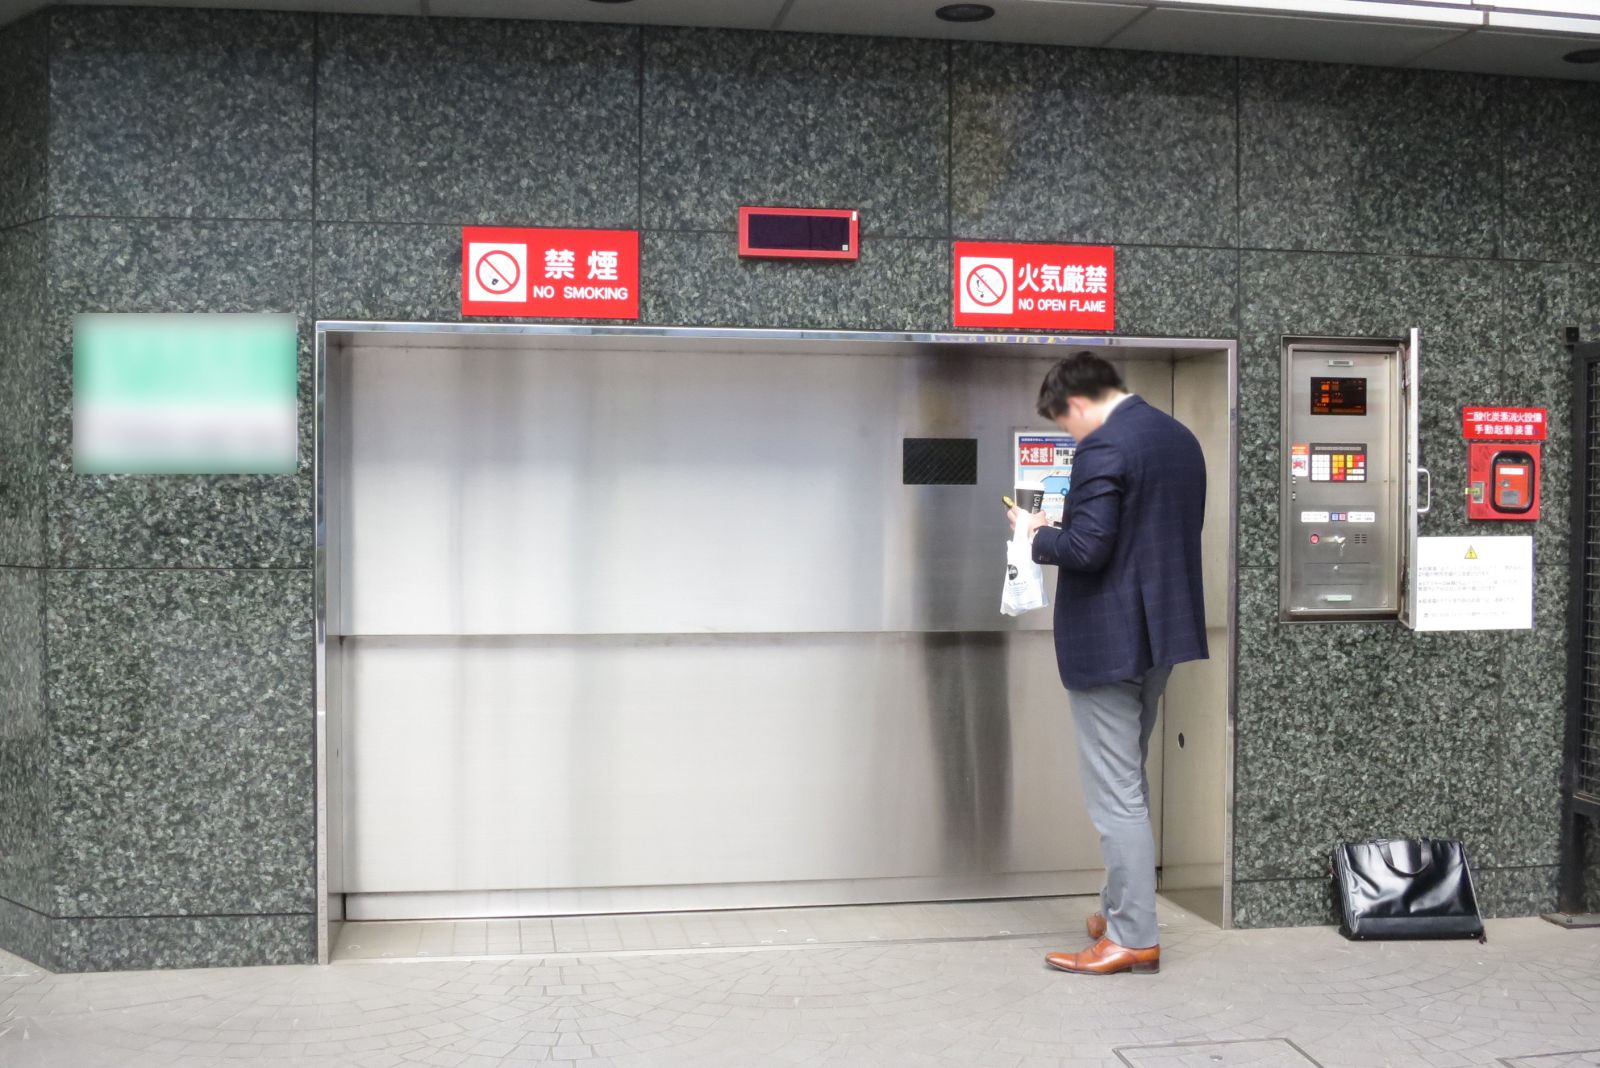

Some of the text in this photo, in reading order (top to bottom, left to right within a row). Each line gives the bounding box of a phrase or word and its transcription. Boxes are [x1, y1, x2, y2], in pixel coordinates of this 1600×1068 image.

[544, 249, 618, 280] 禁煙
[1017, 263, 1108, 294] 火気厳禁
[533, 285, 629, 301] NO SMOKING
[1018, 297, 1106, 313] NO OPEN FLAME
[1465, 411, 1543, 423] 二酸化炭素消火設備
[1474, 424, 1534, 436] 手動起動装置
